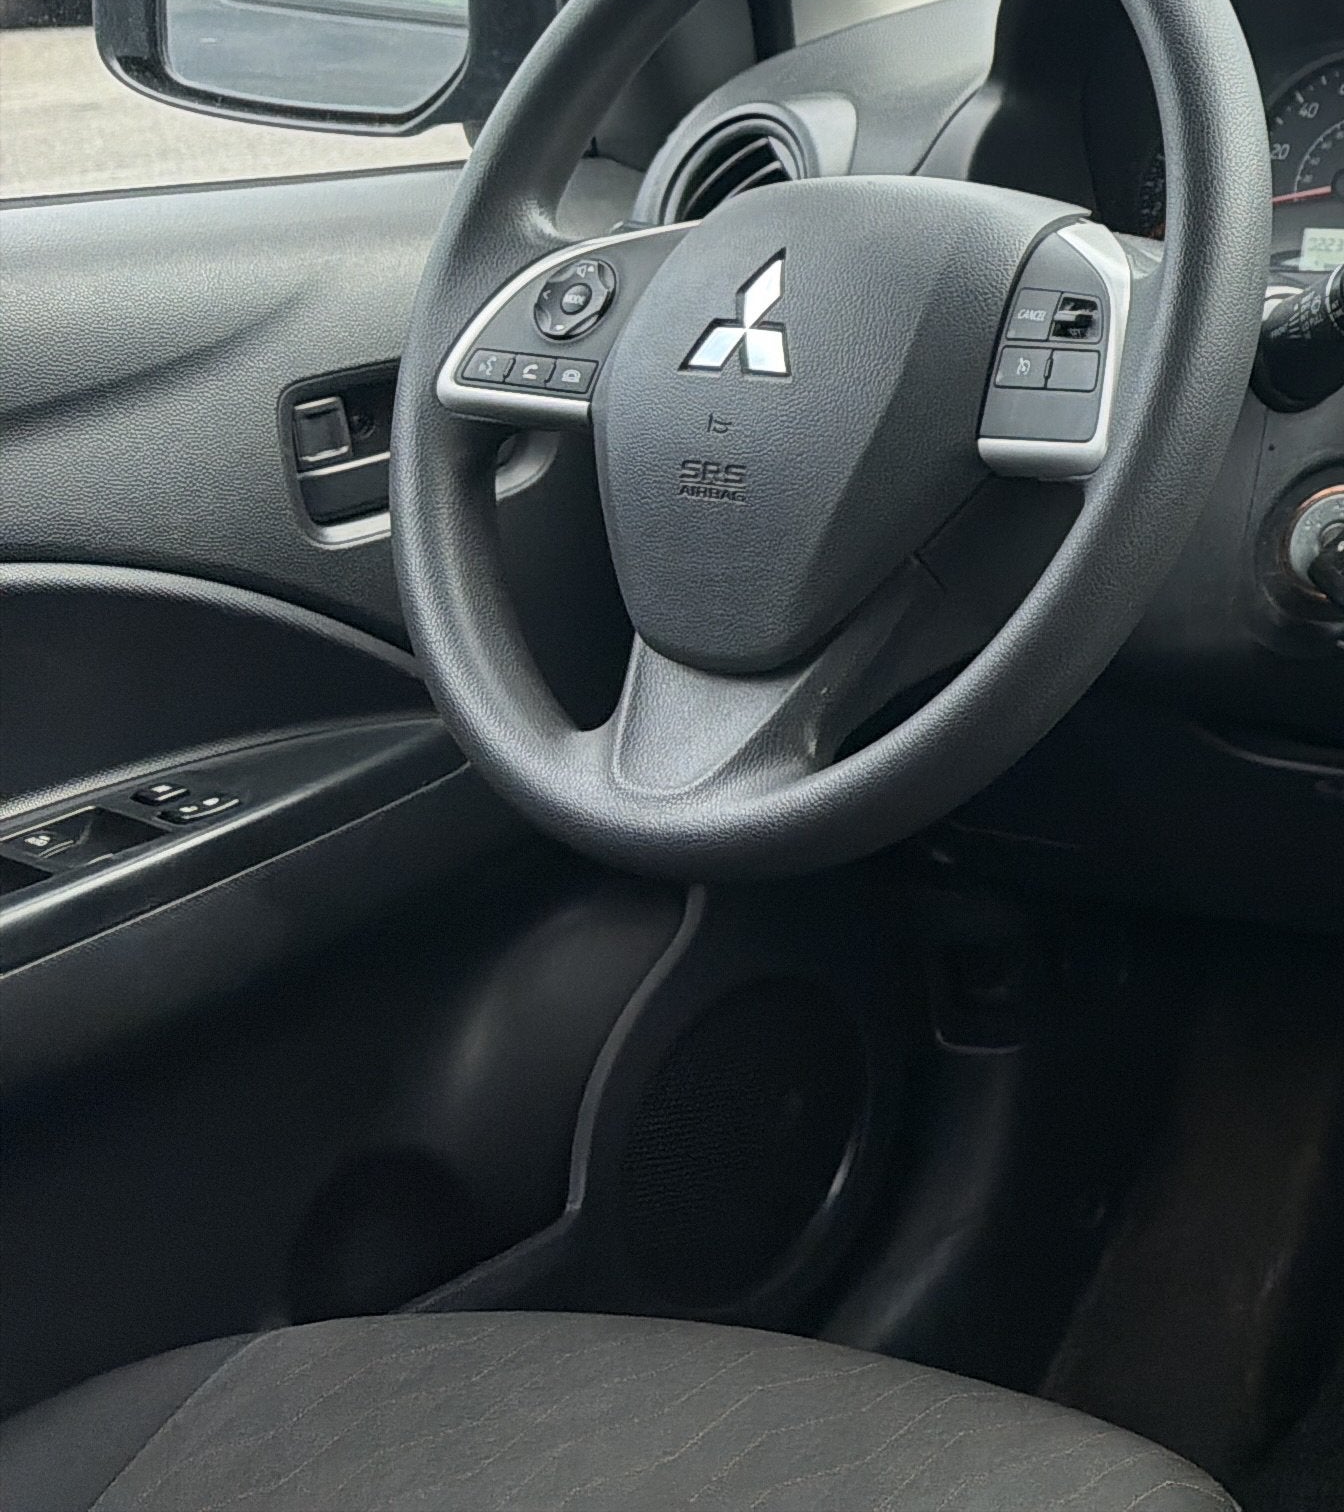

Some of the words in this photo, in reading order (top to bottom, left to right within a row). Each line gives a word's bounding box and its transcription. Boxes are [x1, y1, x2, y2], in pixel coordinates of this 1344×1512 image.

[1299, 101, 1319, 119] 40
[1270, 143, 1290, 160] 20
[679, 458, 747, 484] SRS
[678, 484, 748, 502] AIRBAG
